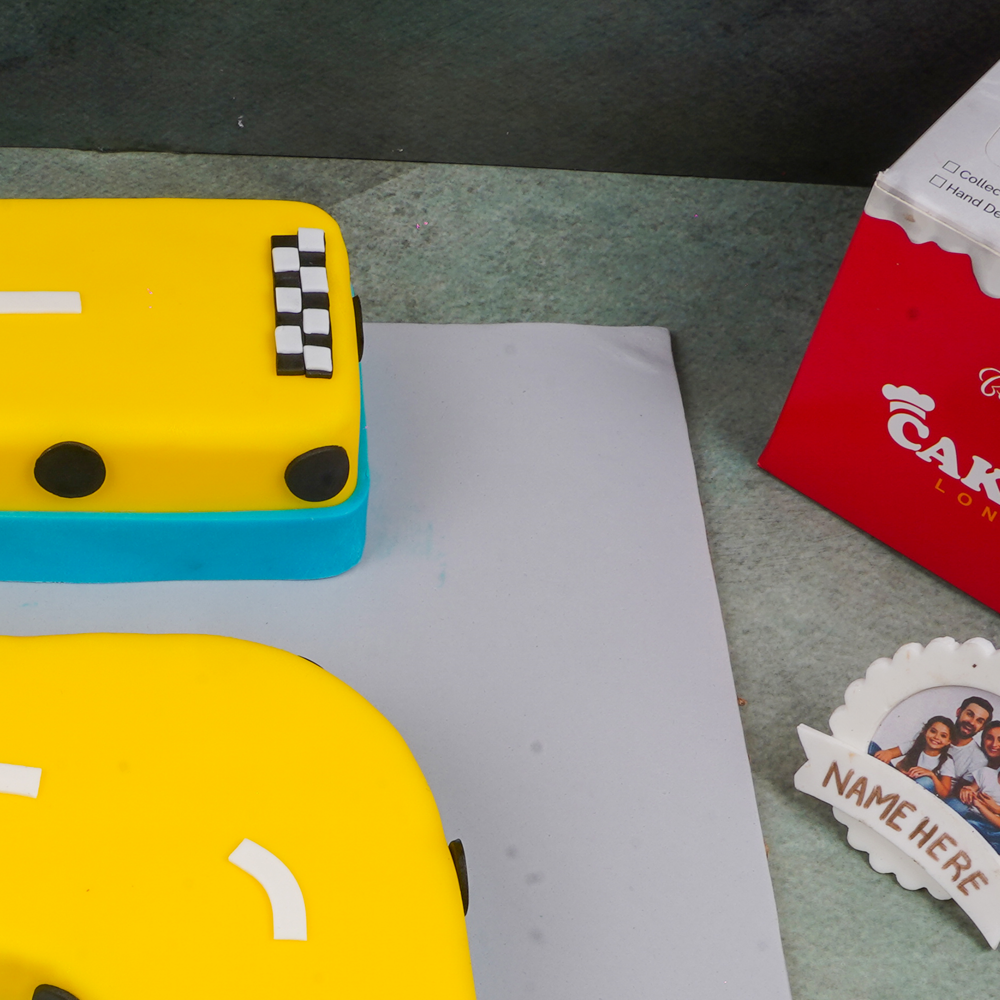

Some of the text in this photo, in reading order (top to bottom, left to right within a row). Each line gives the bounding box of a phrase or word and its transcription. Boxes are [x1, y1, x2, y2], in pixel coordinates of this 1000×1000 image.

[946, 183, 984, 207] Hand
[934, 478, 998, 522] LON
[822, 760, 990, 897] NAME HERE
